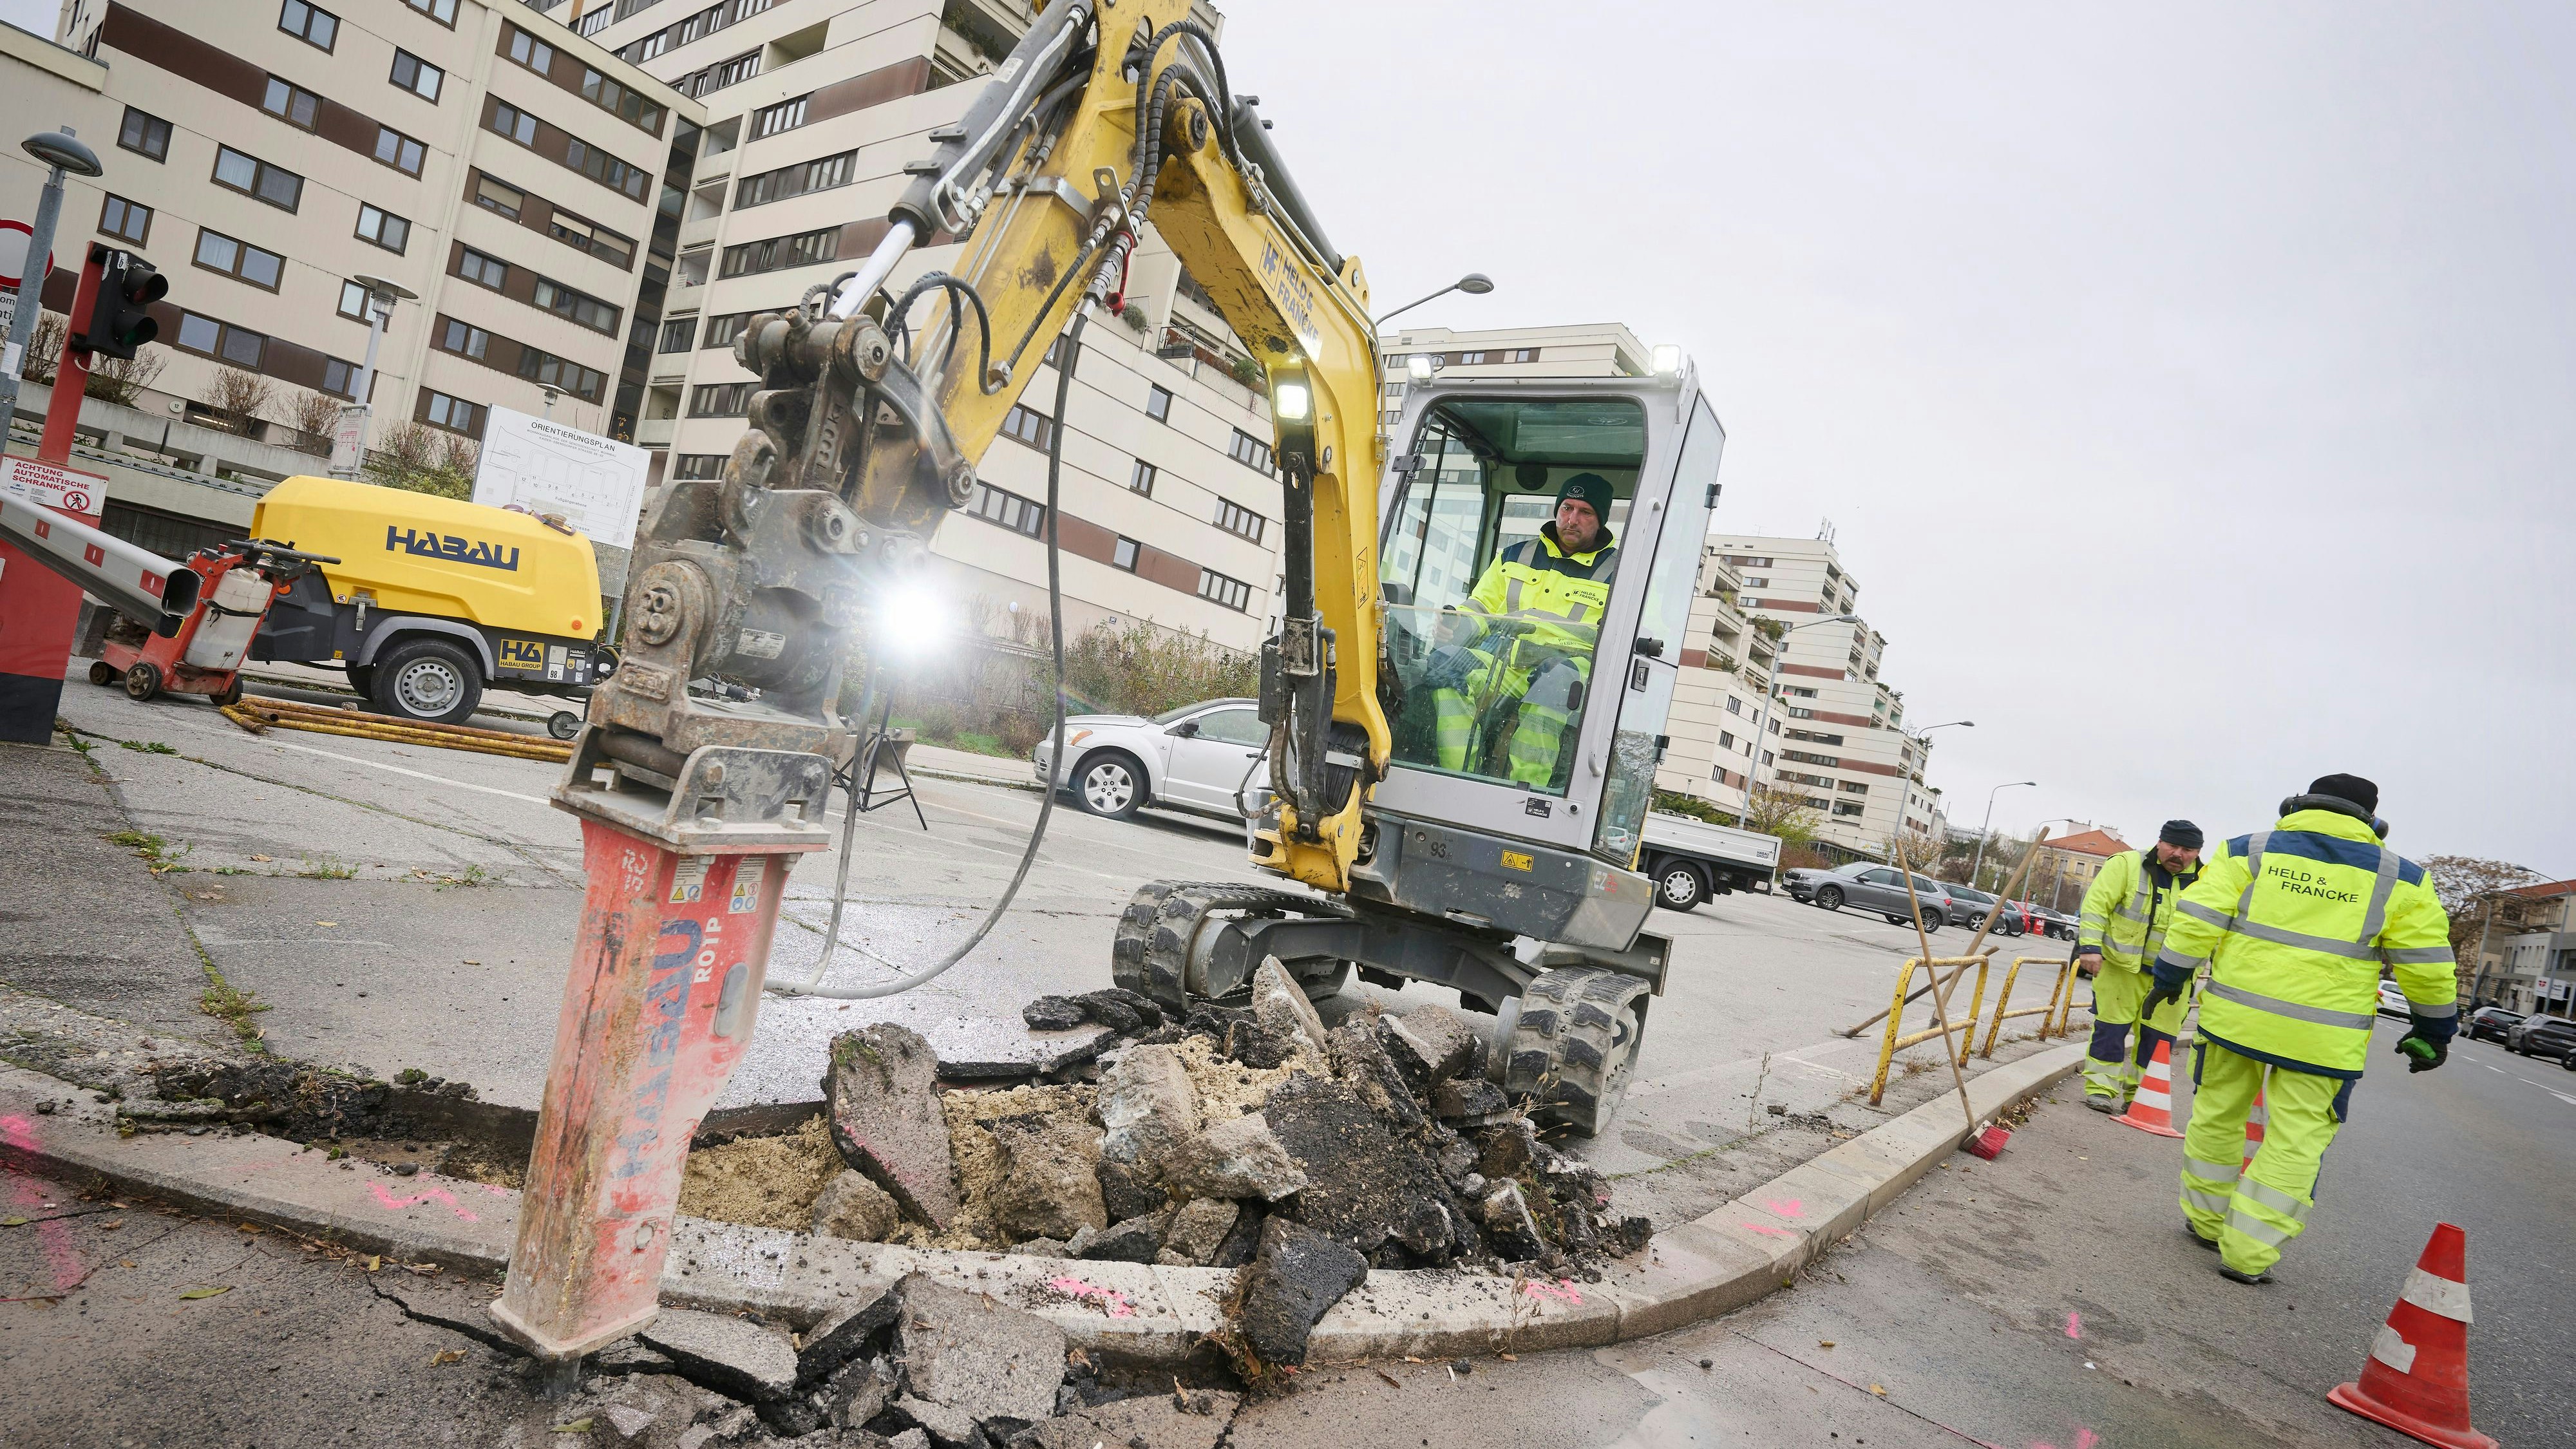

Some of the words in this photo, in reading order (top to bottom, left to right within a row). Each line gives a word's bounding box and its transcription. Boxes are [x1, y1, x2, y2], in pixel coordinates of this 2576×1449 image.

[1283, 256, 1307, 301] HELD
[1277, 279, 1318, 342] FRANCKE
[531, 422, 615, 451] ORIENTIERUNGSPLAN
[14, 468, 90, 490] AUTOMATISCHE
[15, 462, 63, 477] ACHTUNG
[12, 475, 67, 491] SCHRANKE
[386, 526, 520, 572] HABAU
[1580, 594, 1600, 602] FRANCKE
[550, 670, 558, 678] 98
[1430, 841, 1446, 858] 93
[2268, 866, 2311, 882] HELD
[2316, 876, 2327, 886] &
[2281, 881, 2359, 903] FRANCKE
